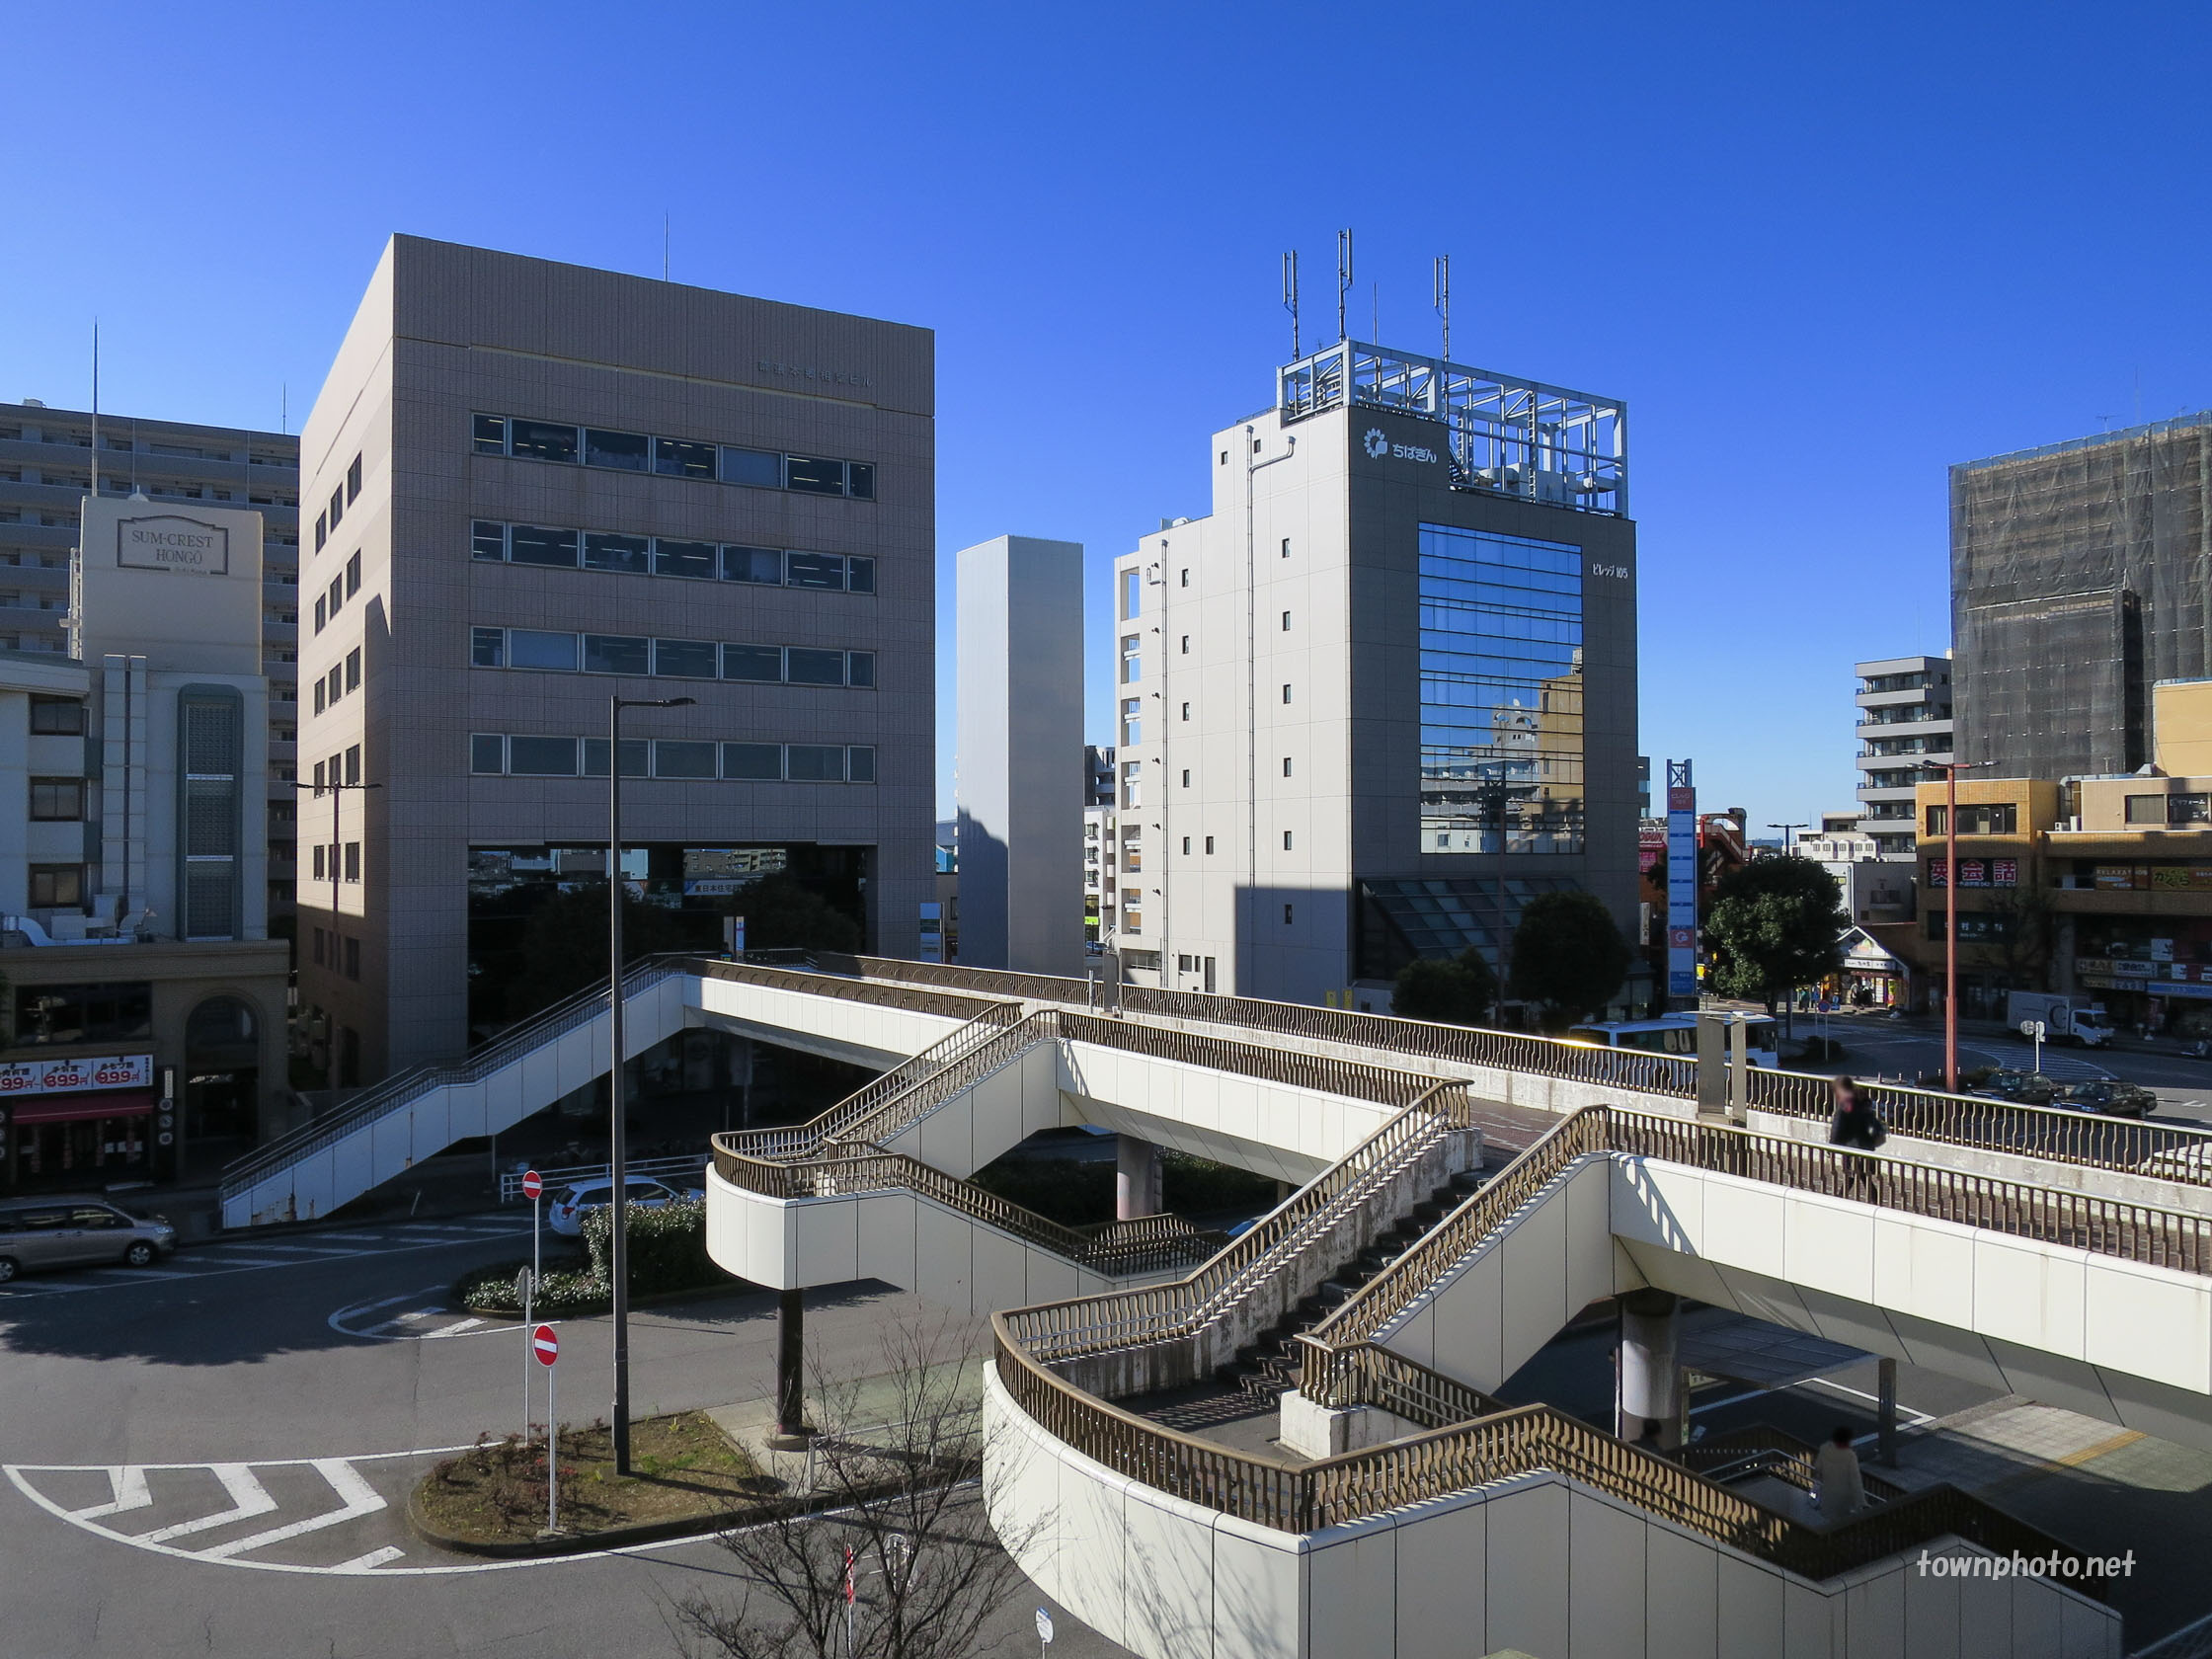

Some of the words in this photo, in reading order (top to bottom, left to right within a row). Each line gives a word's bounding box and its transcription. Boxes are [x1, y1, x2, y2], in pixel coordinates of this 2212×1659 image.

[1392, 443, 1437, 463] ちばぎん
[131, 530, 213, 548] SUM-CREST
[156, 549, 202, 565] HONGO
[1593, 563, 1615, 577] ビレッジ
[1617, 567, 1628, 580] 105
[1931, 859, 2015, 882] 英会話
